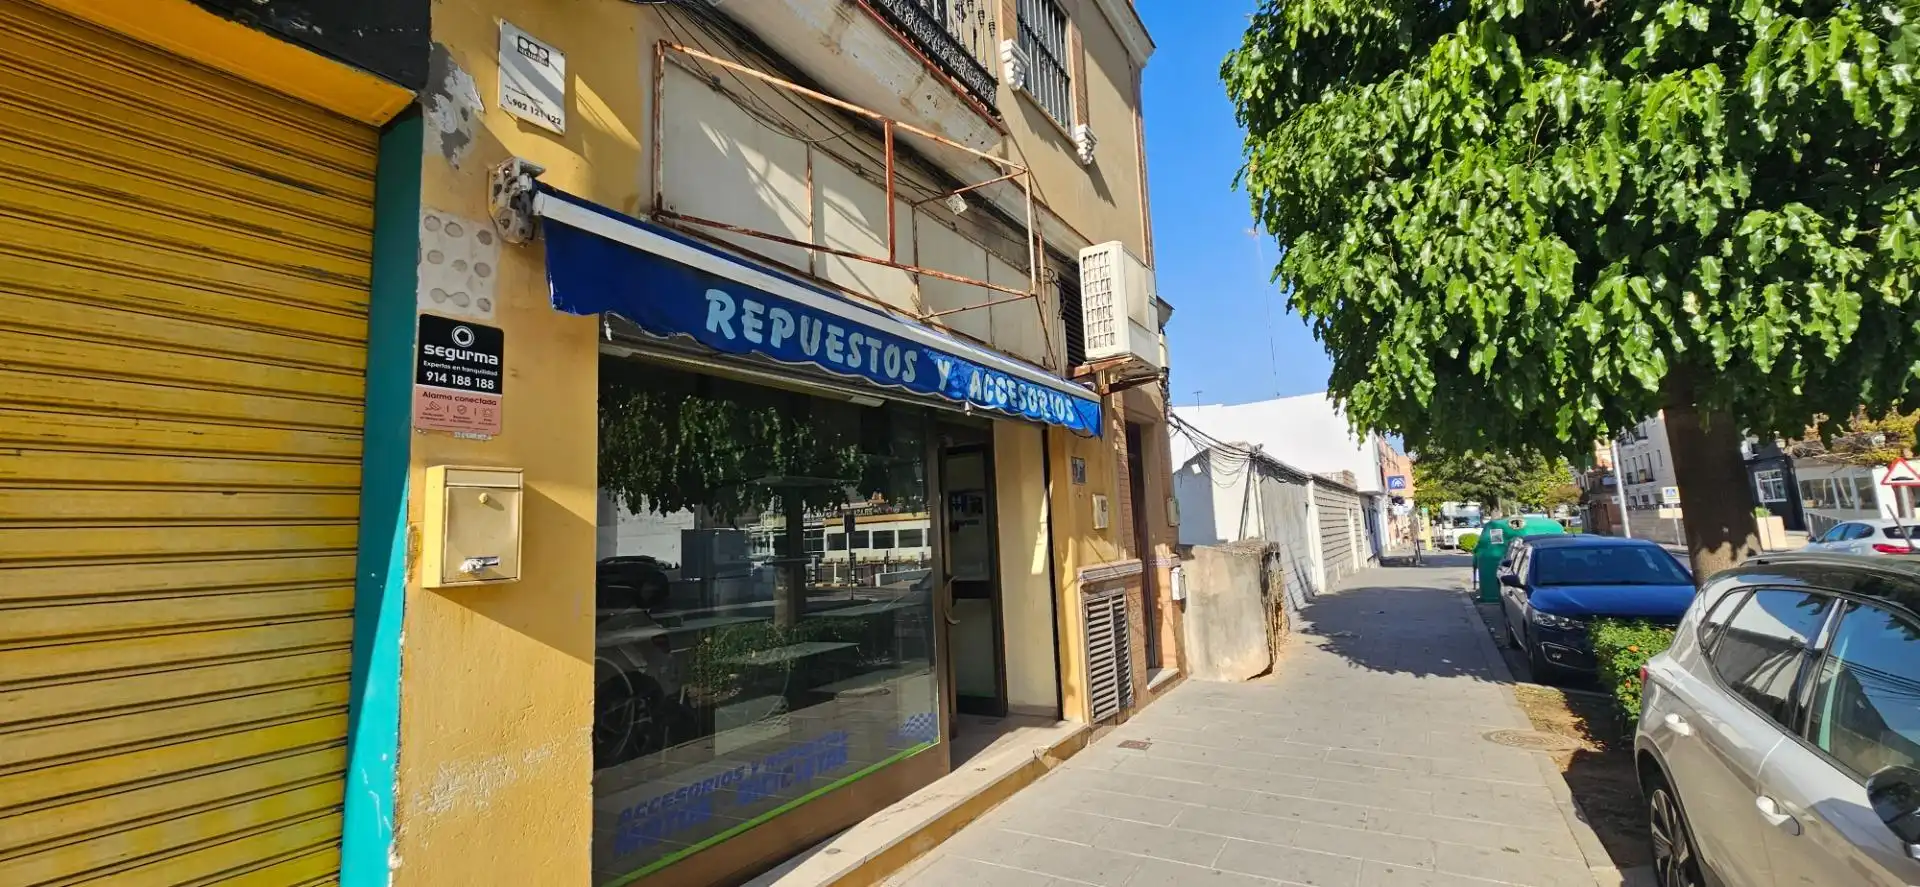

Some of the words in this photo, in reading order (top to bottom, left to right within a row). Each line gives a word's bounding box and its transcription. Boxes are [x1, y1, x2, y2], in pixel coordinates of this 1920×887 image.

[512, 99, 528, 111] 902
[423, 344, 499, 366] segurma
[705, 288, 918, 383] REPUESTOS
[936, 360, 952, 391] Y
[967, 371, 1075, 422] ACCESORIOS
[423, 360, 451, 370] Expertos
[462, 366, 498, 376] tranquilidad
[426, 371, 447, 384] 914
[451, 374, 472, 387] 188
[475, 377, 495, 390] 188
[422, 391, 453, 401] Alarma
[454, 395, 497, 406] conectada
[616, 764, 745, 826] ACCESORIOS
